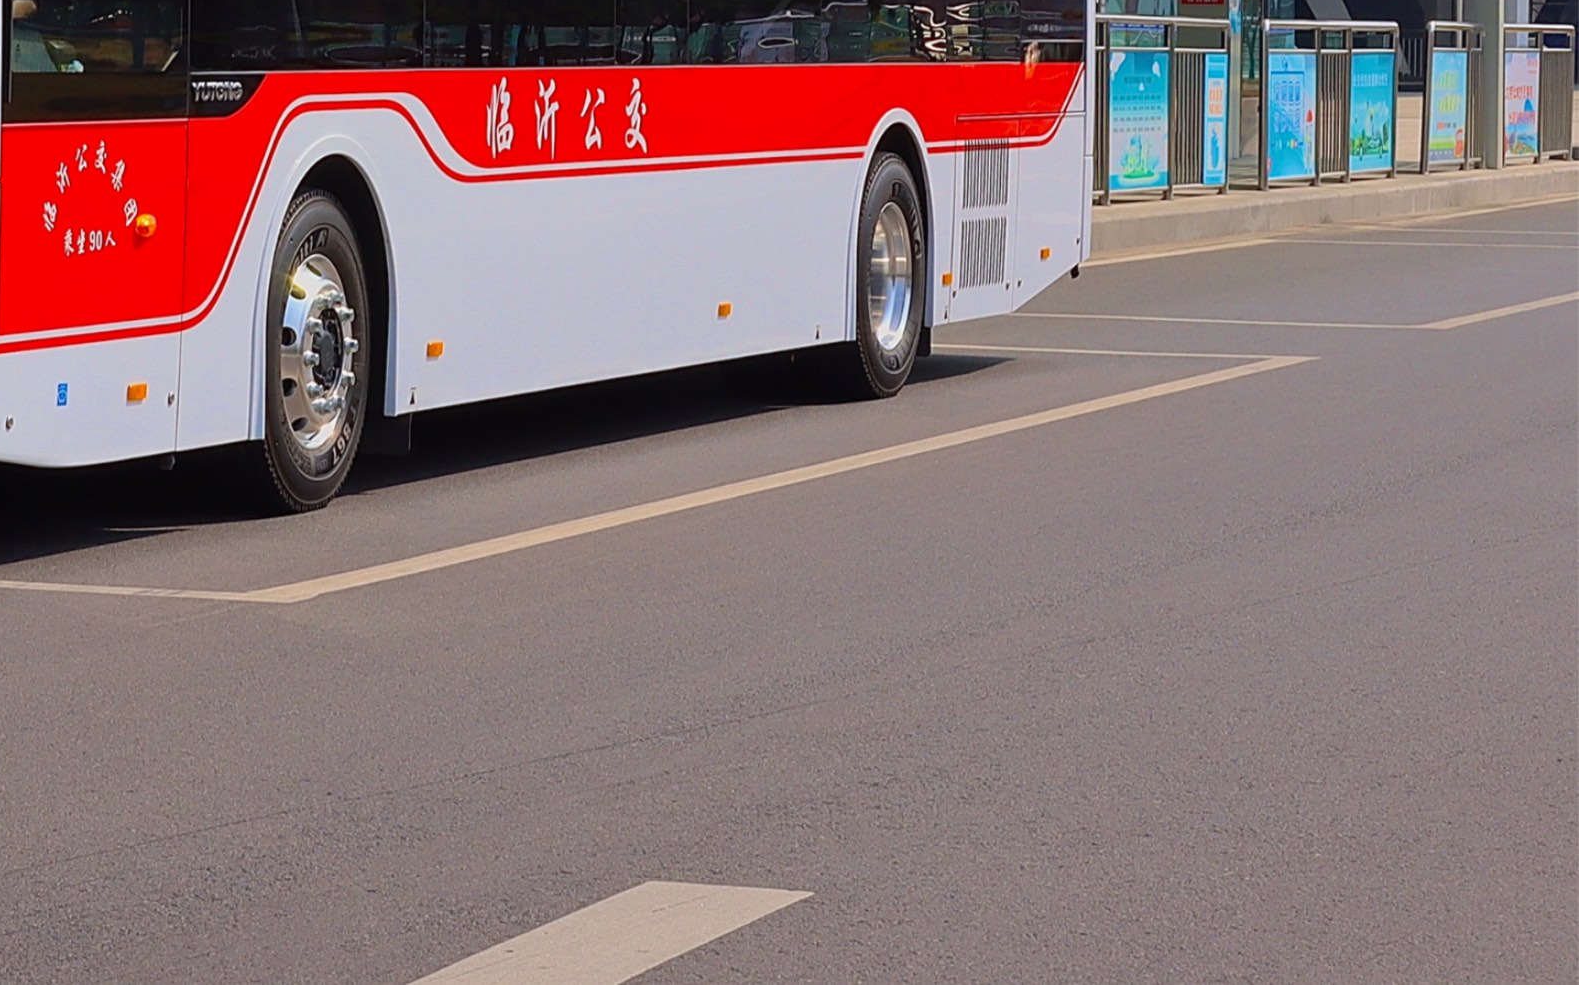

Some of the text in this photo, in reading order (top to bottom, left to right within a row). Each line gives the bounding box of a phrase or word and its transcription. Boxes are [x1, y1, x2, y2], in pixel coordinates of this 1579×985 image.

[191, 81, 243, 102] YUTONG
[486, 76, 648, 160] 临沂公交
